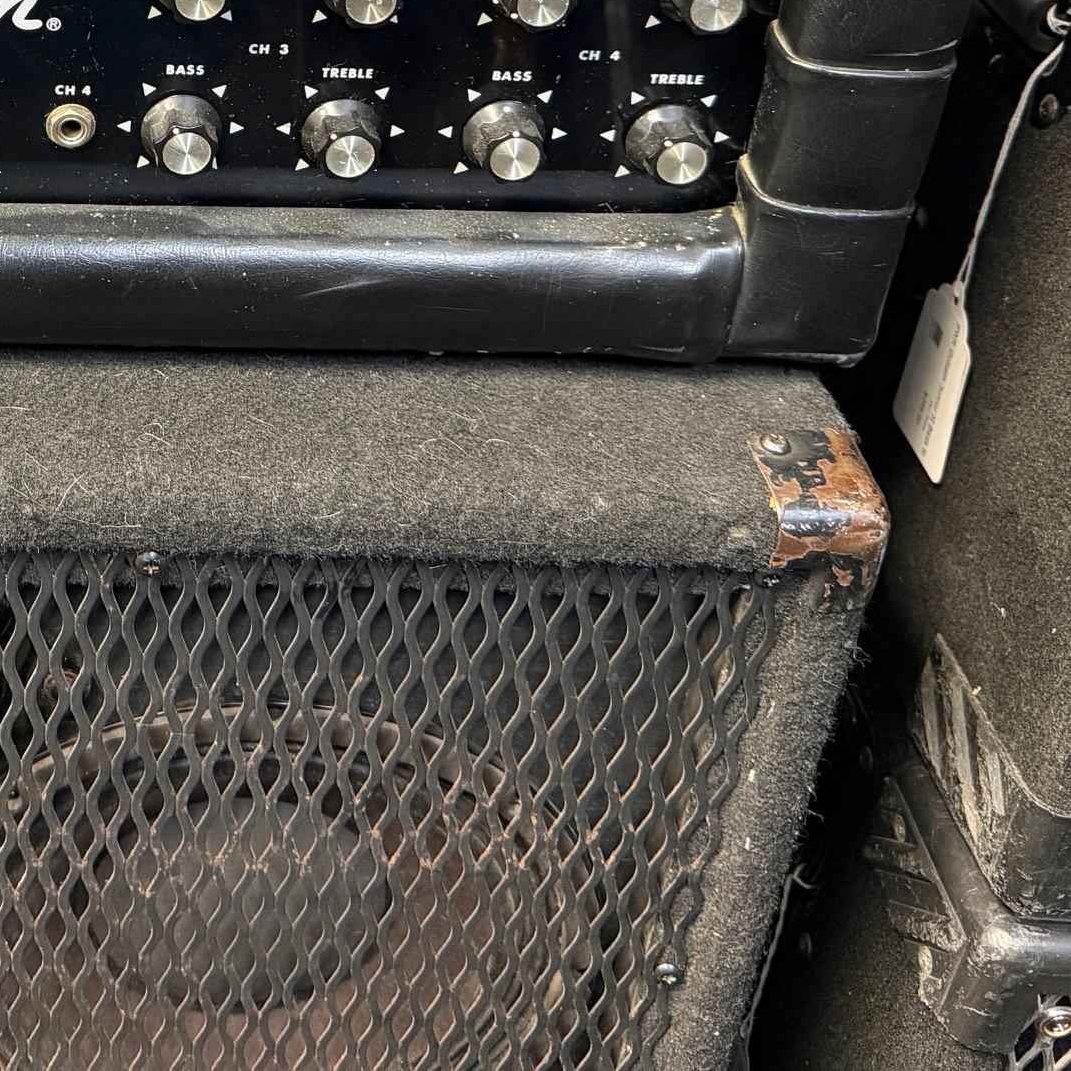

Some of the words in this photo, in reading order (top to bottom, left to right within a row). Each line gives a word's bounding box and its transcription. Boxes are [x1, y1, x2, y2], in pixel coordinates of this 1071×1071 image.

[248, 43, 270, 55] CH
[279, 44, 290, 55] 3
[579, 50, 600, 61] CH
[609, 50, 621, 61] 4
[166, 64, 205, 76] BASS
[322, 67, 374, 79] TREBLE
[492, 70, 532, 82] BASS
[650, 74, 704, 86] TREBLE
[54, 85, 76, 96] CH
[80, 85, 91, 96] 4
